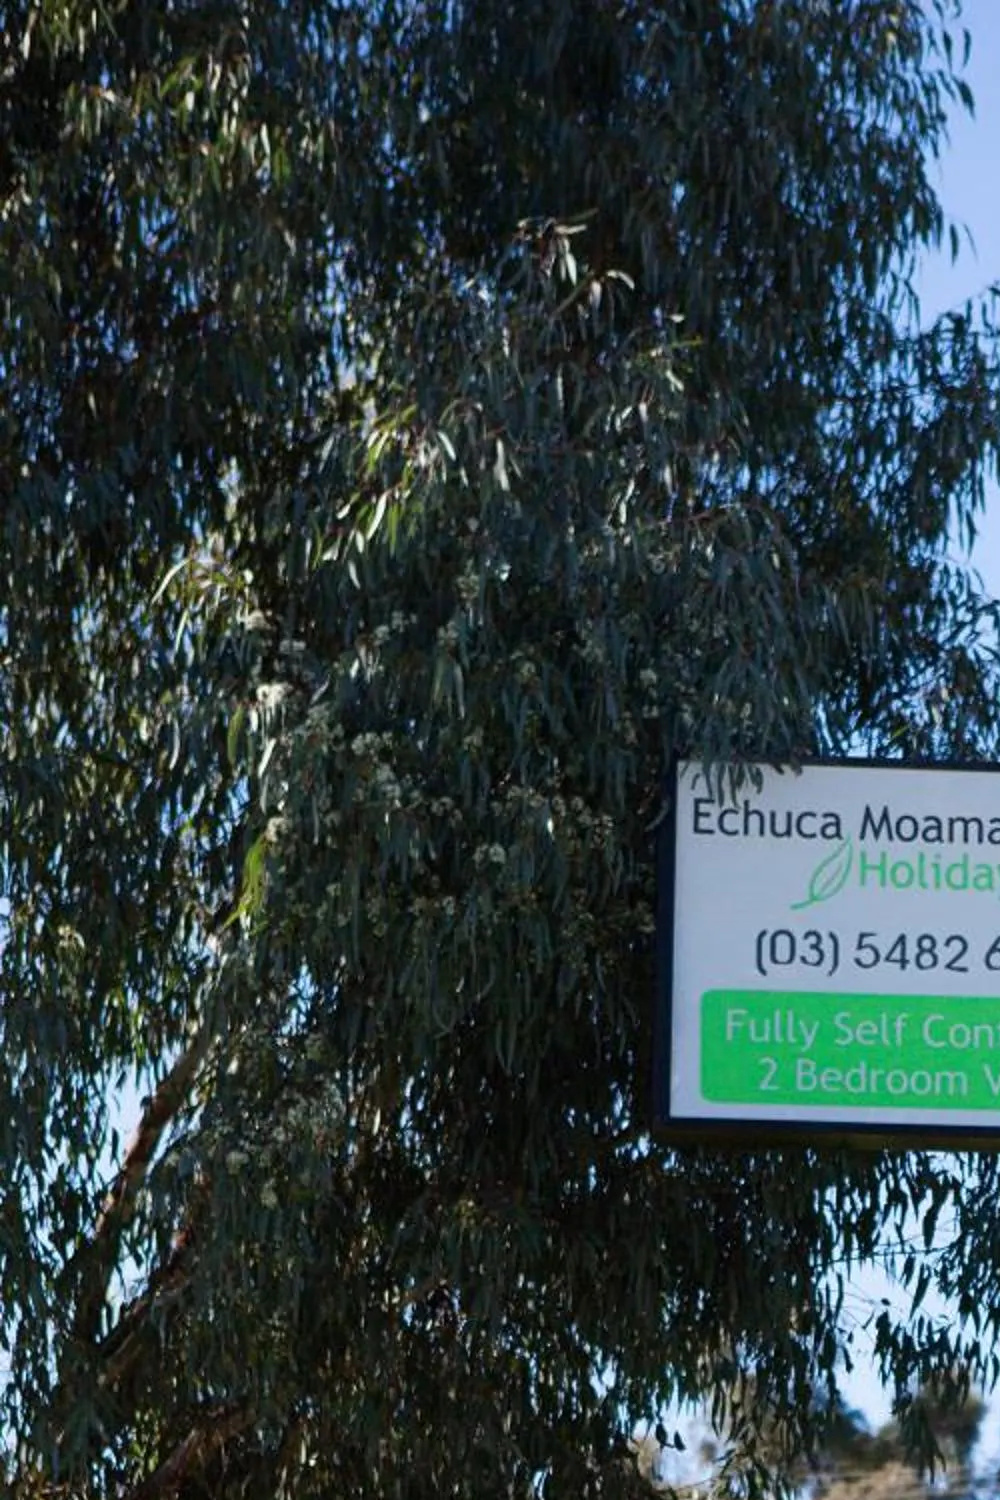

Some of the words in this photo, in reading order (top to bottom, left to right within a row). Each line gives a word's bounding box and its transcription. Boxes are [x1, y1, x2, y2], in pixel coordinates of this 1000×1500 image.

[692, 798, 842, 841] Echuca
[756, 929, 839, 977] (03)
[855, 933, 969, 971] 5482
[726, 1010, 819, 1051] Fully
[835, 1012, 907, 1046] Self
[759, 1058, 779, 1091] 2
[798, 1061, 967, 1096] Bedroom
